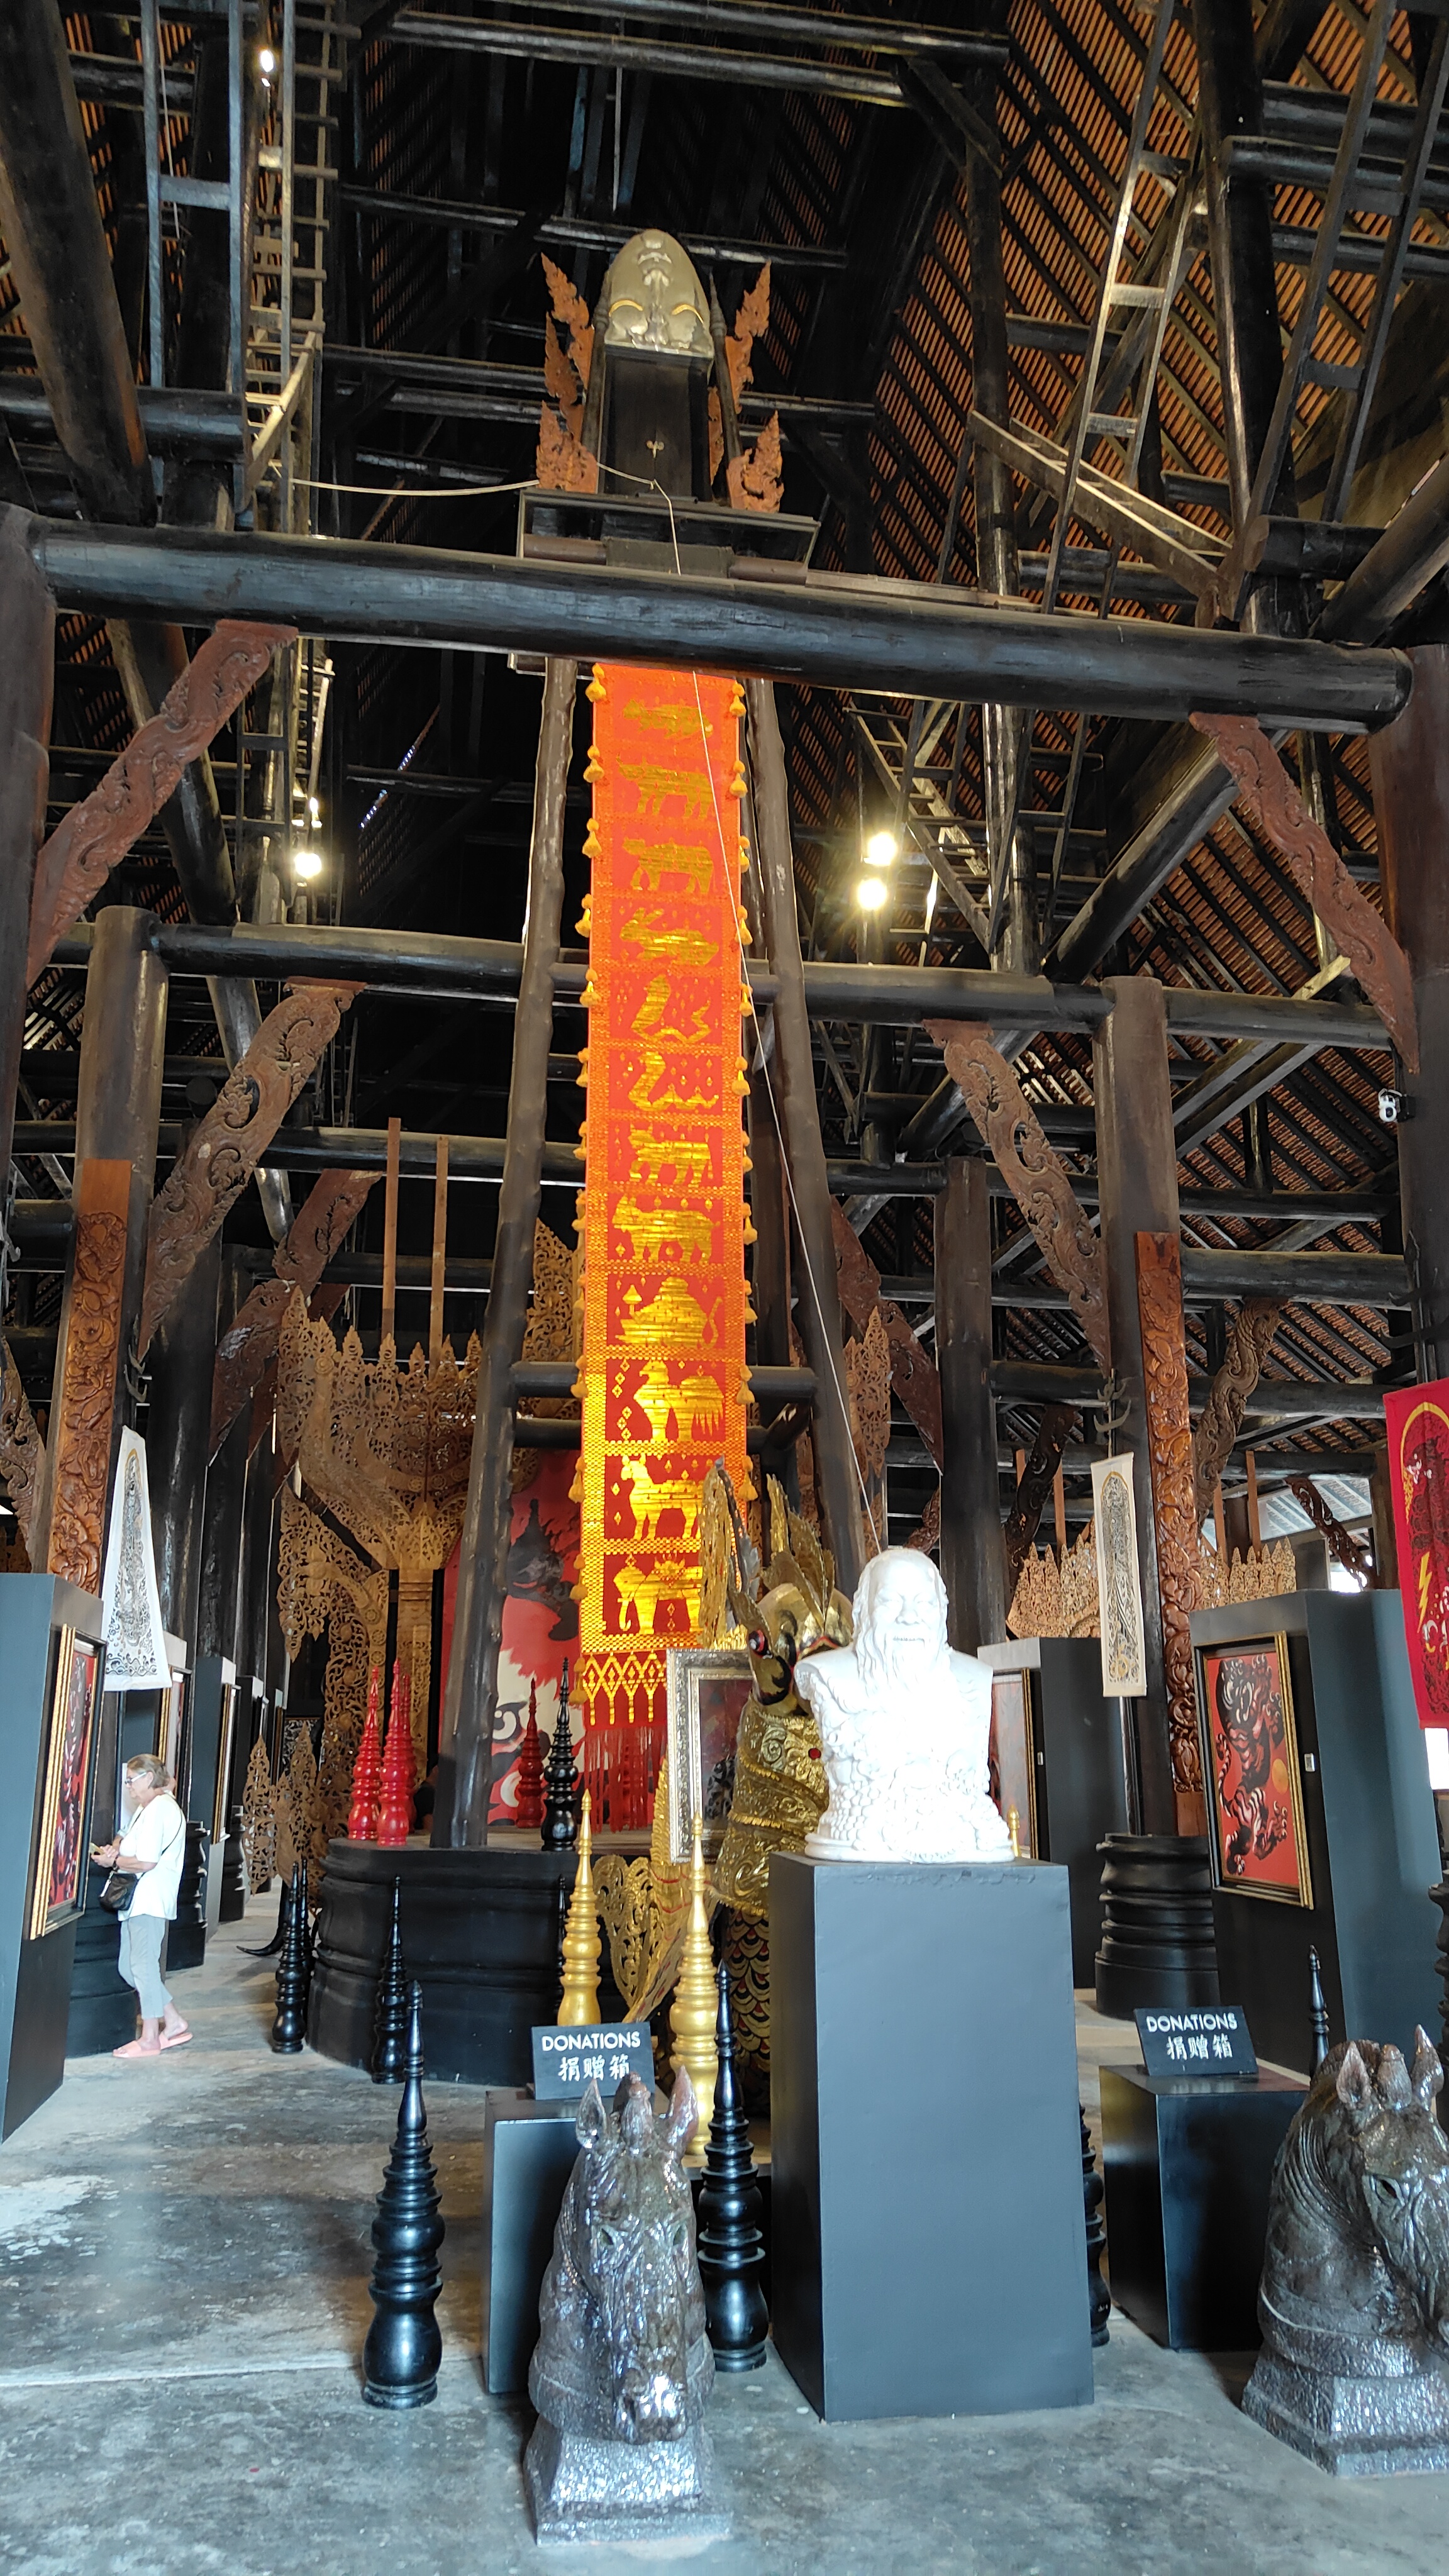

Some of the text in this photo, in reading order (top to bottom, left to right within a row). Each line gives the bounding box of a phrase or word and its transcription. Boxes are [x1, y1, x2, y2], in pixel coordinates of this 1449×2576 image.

[1146, 2012, 1238, 2033] DONATIONS
[541, 2031, 641, 2051] DONATIONS
[1166, 2033, 1233, 2061] 捐赠箱
[558, 2053, 630, 2082] 捐赠箱
